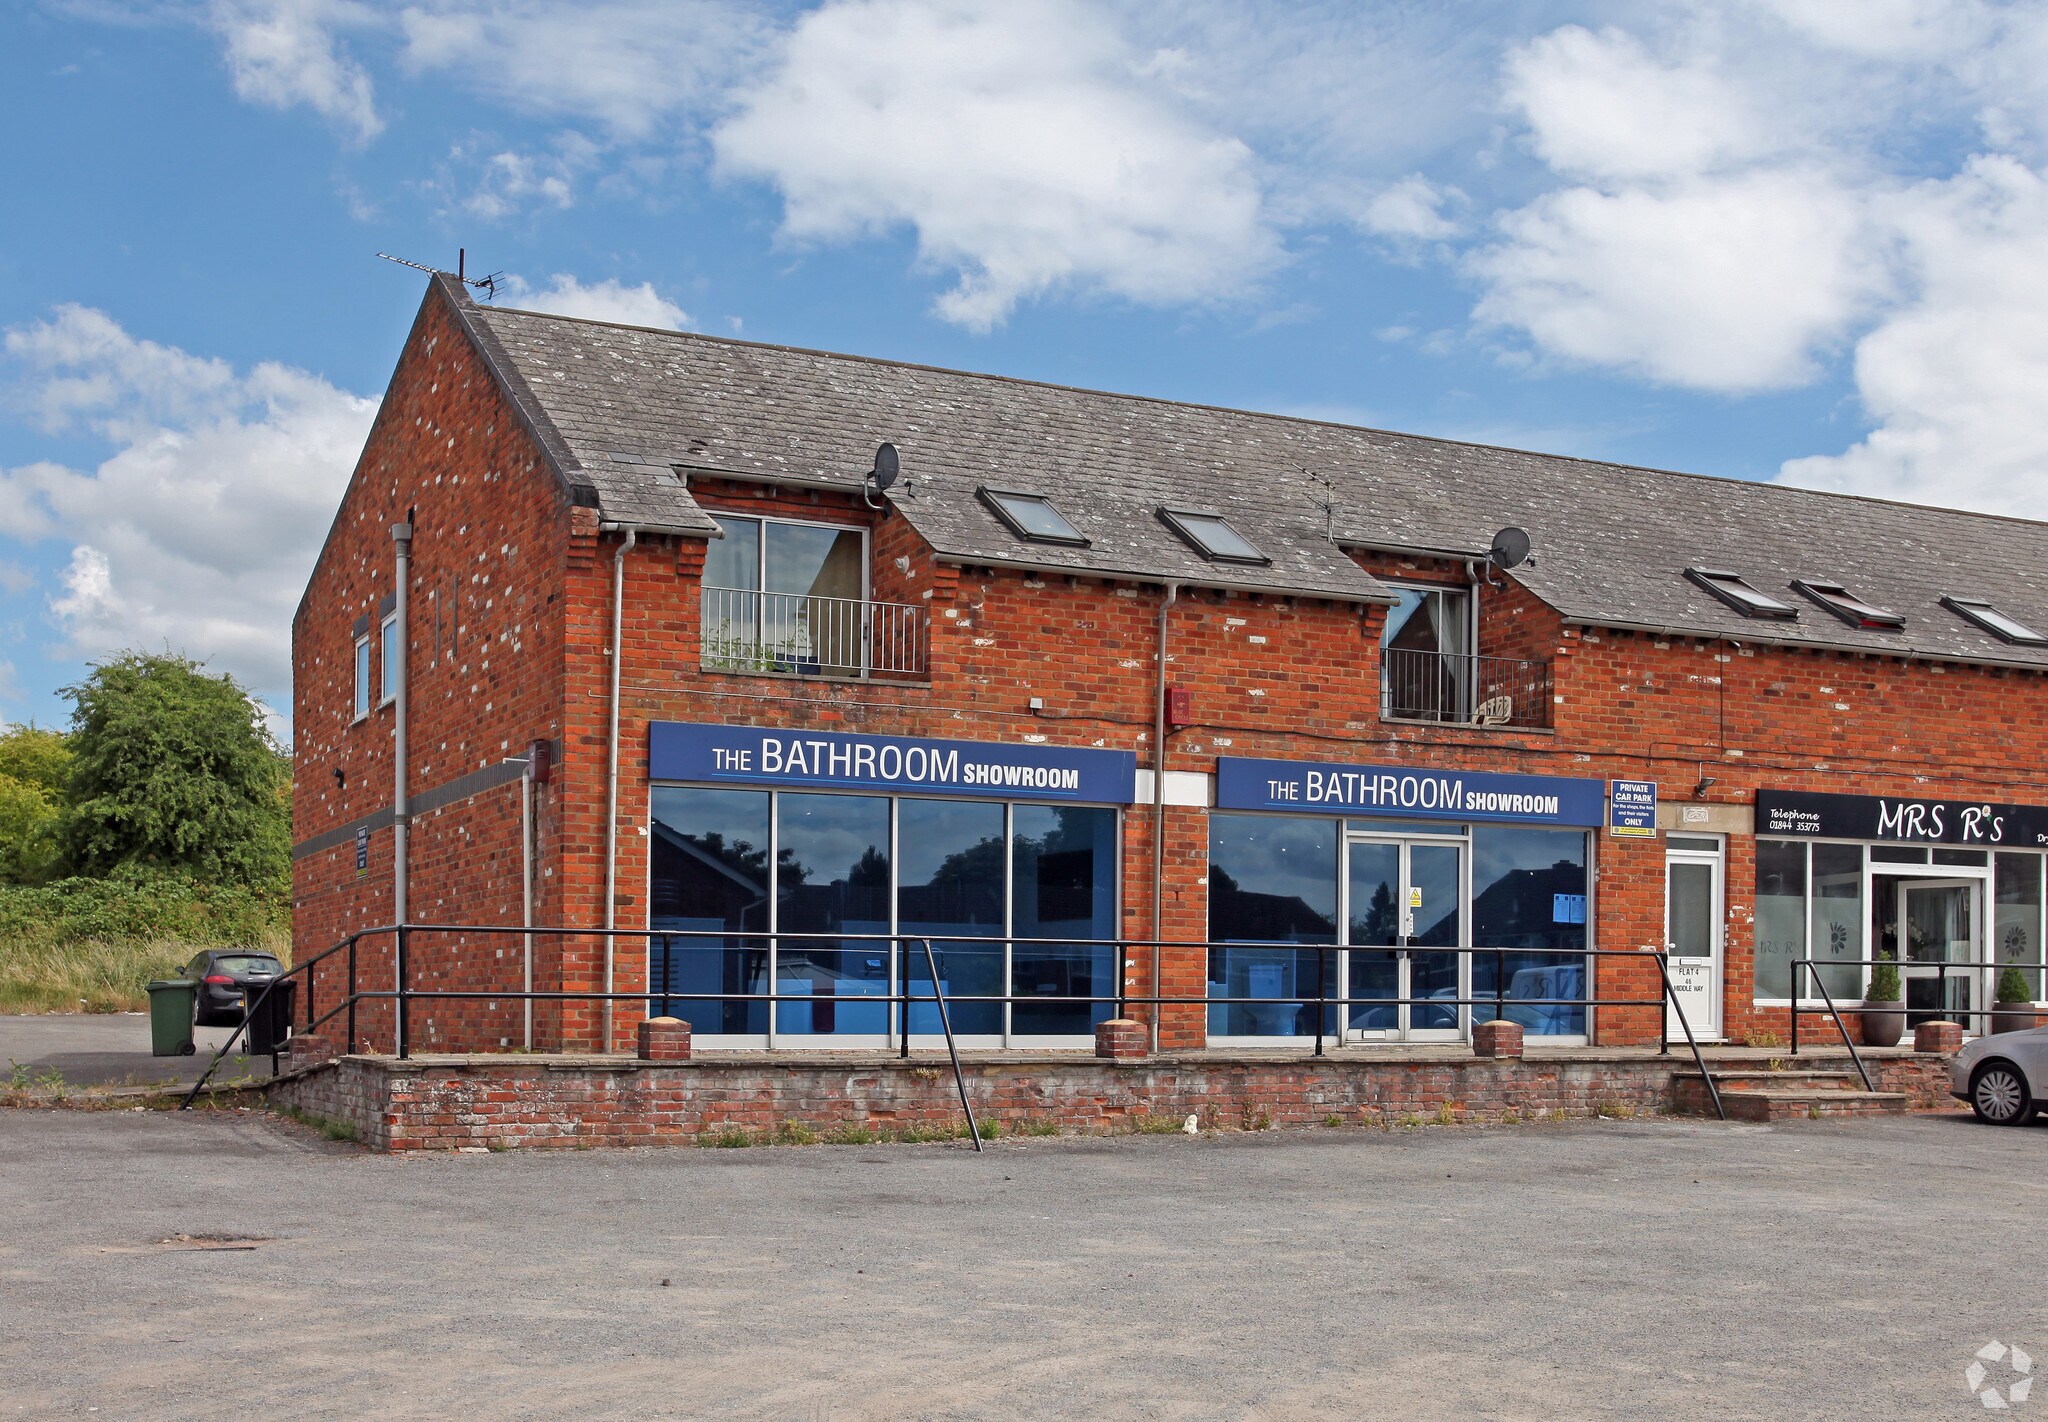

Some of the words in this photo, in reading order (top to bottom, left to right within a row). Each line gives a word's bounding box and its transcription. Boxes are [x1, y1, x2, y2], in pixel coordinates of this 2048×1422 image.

[712, 748, 752, 771] THE
[762, 738, 958, 783] BATHROOM
[963, 763, 1079, 789] SHOWROOM
[1267, 780, 1299, 800] THE
[1306, 771, 1462, 809] BATHROOM
[1466, 792, 1558, 814] SHOWROOM
[1620, 784, 1648, 792] PRIVATE
[1615, 792, 1632, 801] CAR
[1633, 794, 1653, 803] PARK
[1770, 808, 1820, 822] Telephone
[1877, 799, 1945, 839] MRS
[1624, 818, 1643, 826] ONLY
[1769, 820, 1792, 830] 01844
[1796, 822, 1820, 832] 353775
[1679, 967, 1695, 976] FLAT
[1695, 968, 1699, 976] 4
